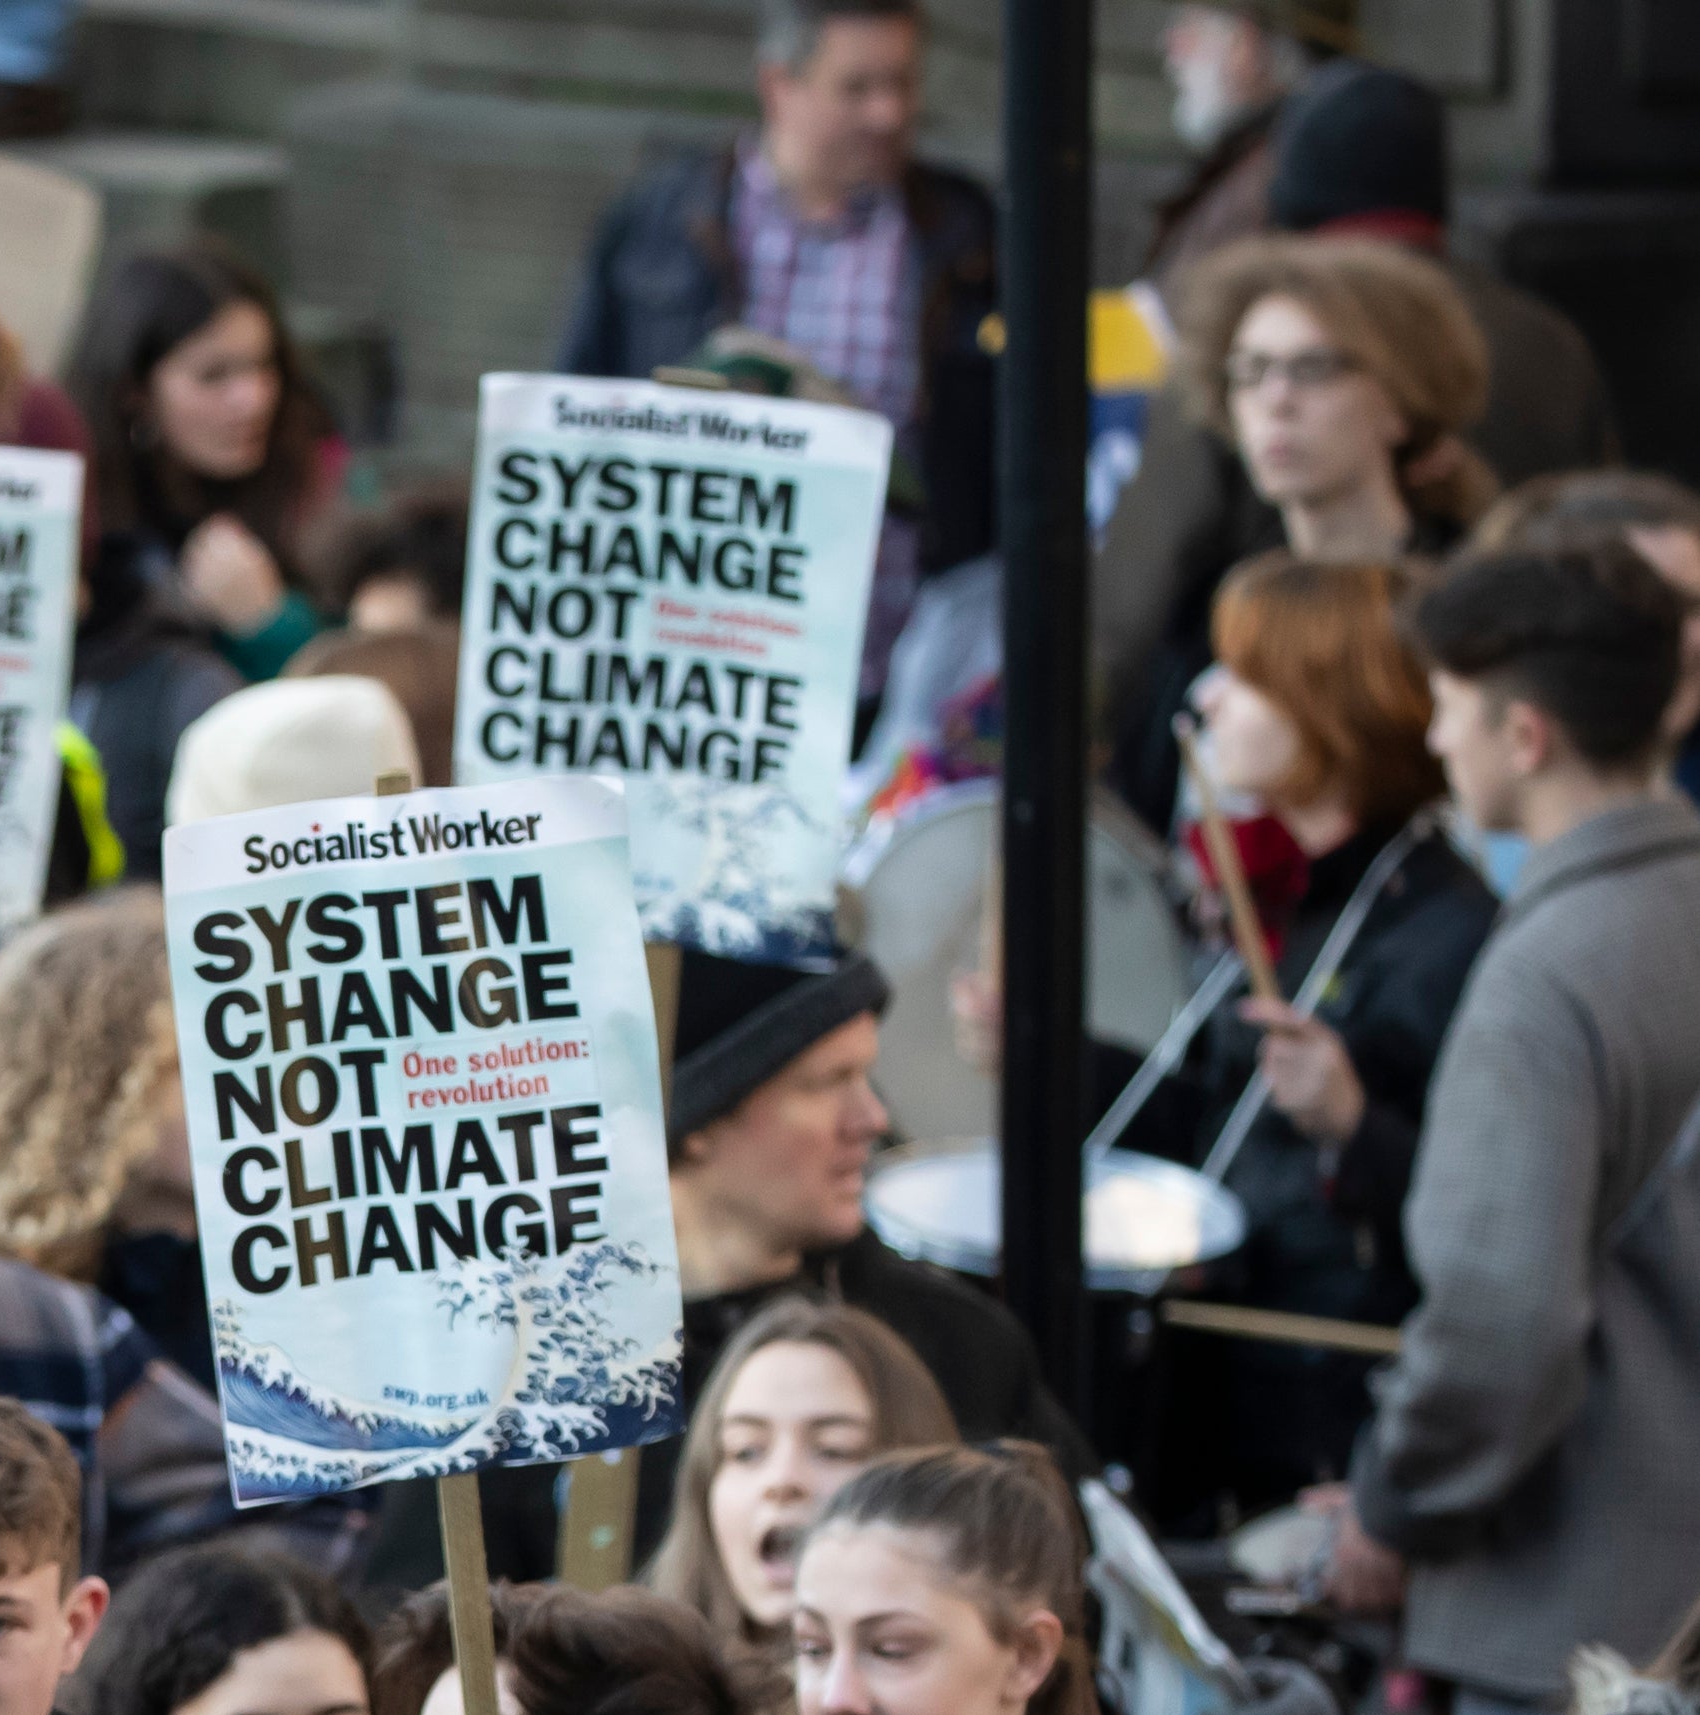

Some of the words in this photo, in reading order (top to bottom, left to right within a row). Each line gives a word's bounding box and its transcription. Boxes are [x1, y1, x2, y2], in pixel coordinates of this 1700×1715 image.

[498, 451, 798, 534] SYSTEM
[494, 519, 805, 602] CHANGE
[491, 581, 639, 641] NOT
[485, 646, 804, 730] CLIMATE
[193, 874, 550, 984] SYSTEM
[203, 949, 580, 1060] CHANGE
[211, 1049, 388, 1141] NOT
[403, 1049, 458, 1079] One
[467, 1037, 590, 1074] solution:
[407, 1073, 550, 1110] revolution
[221, 1102, 611, 1217] CLIMATE
[230, 1181, 607, 1296] CHANGE
